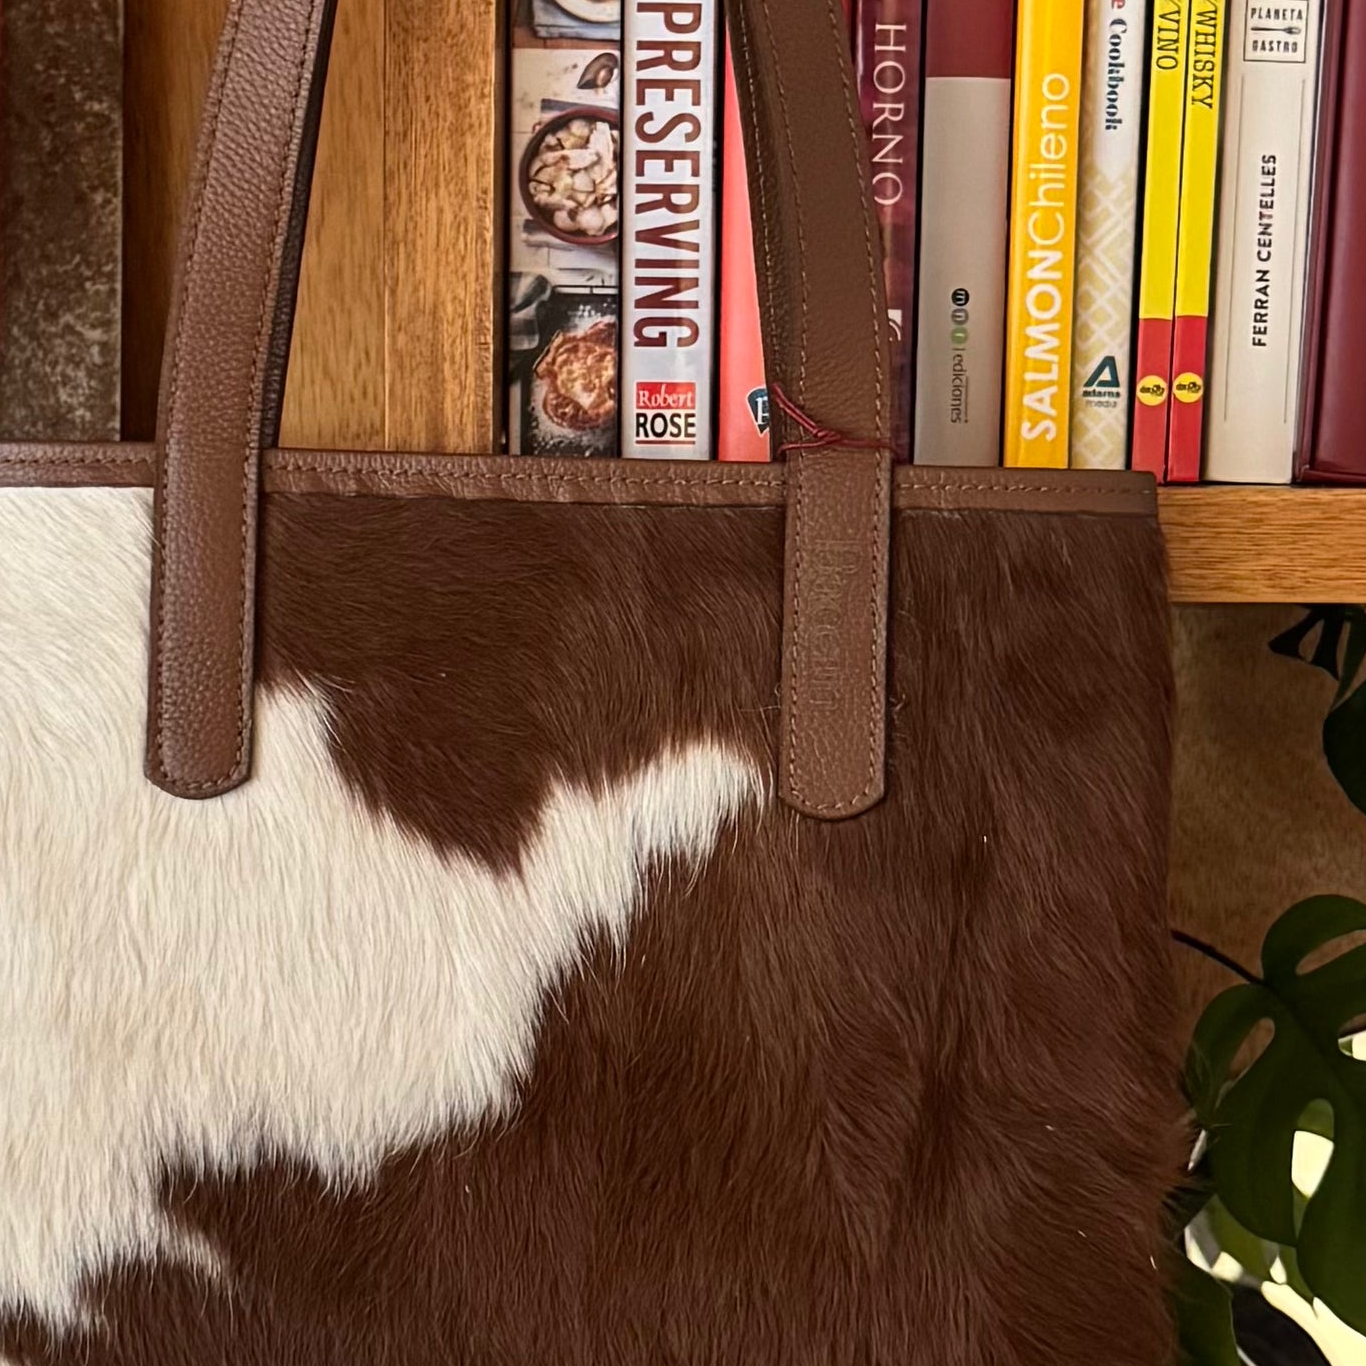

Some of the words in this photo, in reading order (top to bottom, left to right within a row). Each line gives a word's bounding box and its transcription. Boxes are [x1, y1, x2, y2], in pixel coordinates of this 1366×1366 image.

[1156, 7, 1181, 70] VINO
[1251, 7, 1303, 22] PLANETA
[1251, 40, 1298, 54] GASTRO
[1106, 17, 1127, 131] Cookbook
[1191, 8, 1220, 109] WHISKY
[872, 24, 907, 206] HORNO
[633, 3, 701, 349] PRESERVING
[1258, 154, 1277, 263] CENTELLES
[1252, 268, 1271, 347] FERRAN
[636, 413, 696, 438] ROSE
[638, 387, 695, 408] Robert
